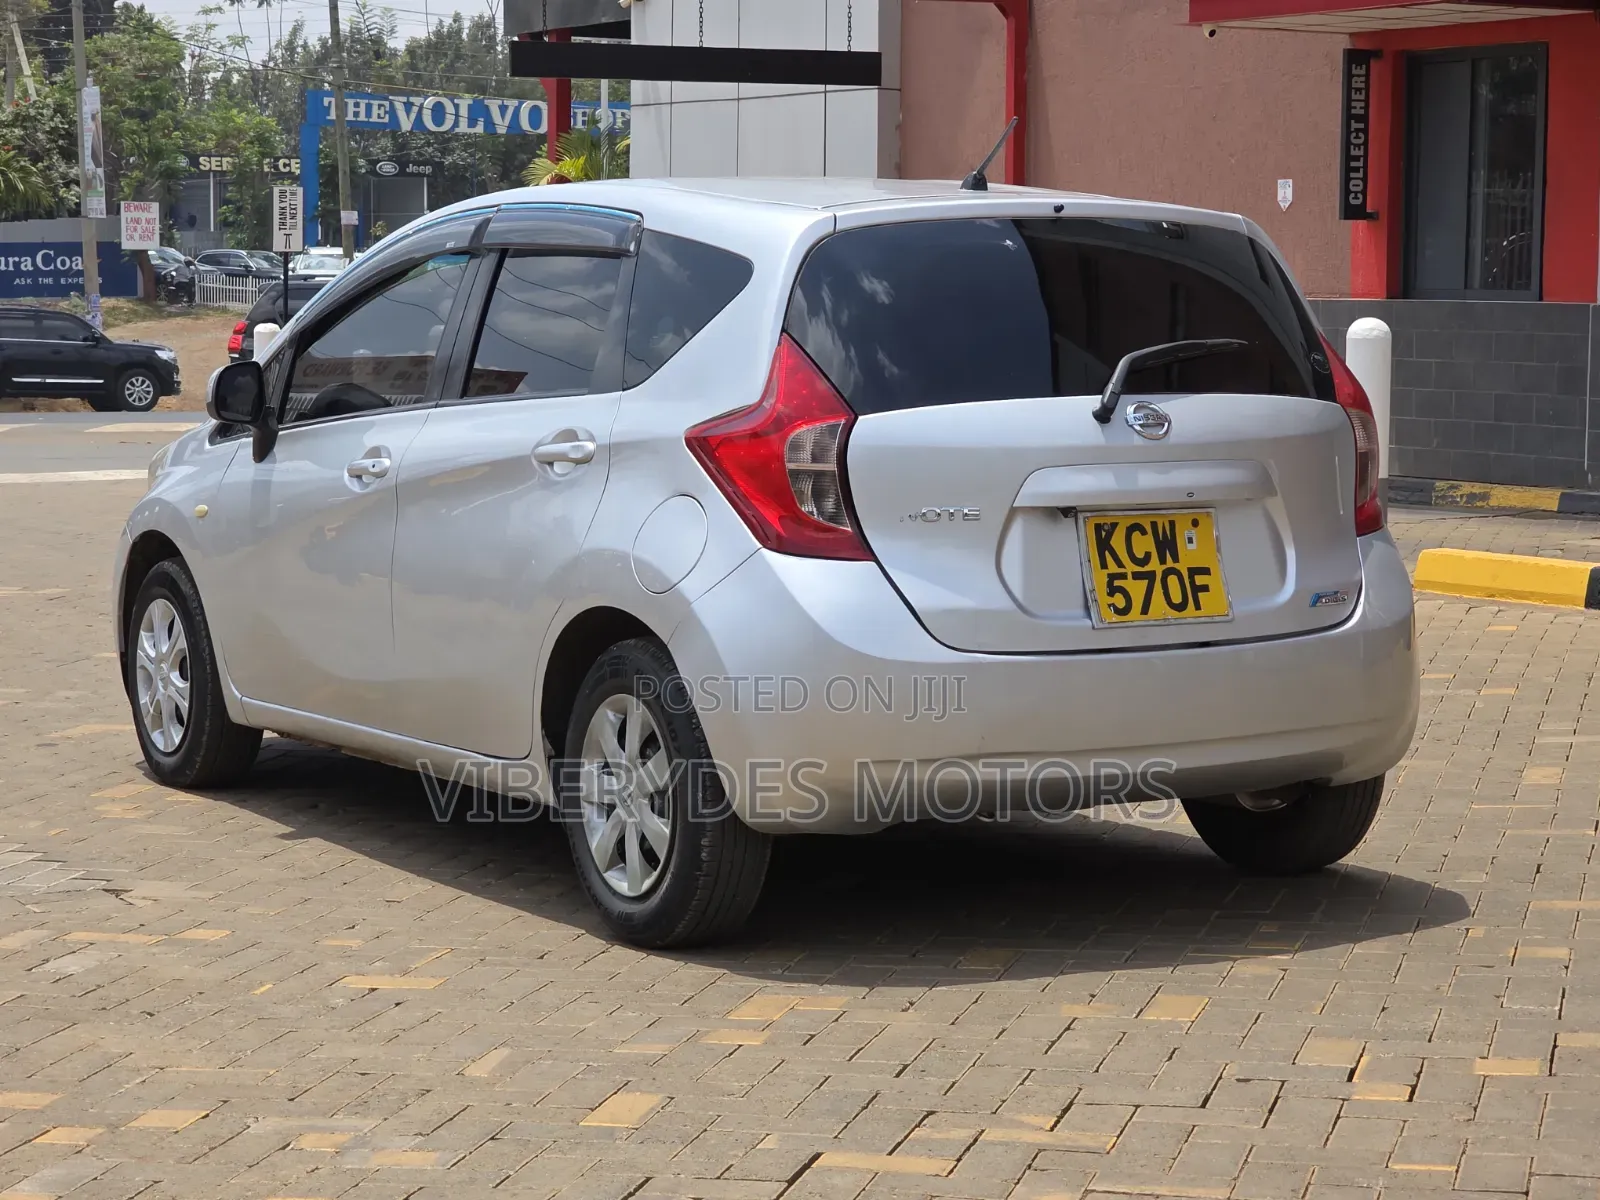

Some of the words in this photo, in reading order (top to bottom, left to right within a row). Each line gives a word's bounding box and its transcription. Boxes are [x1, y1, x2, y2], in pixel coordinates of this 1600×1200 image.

[1352, 63, 1367, 115] HERE
[323, 97, 390, 124] THE
[389, 95, 547, 135] VOLVO
[571, 107, 631, 130] HOP
[199, 156, 273, 173] SERE
[406, 163, 433, 175] Jeep
[1349, 120, 1365, 205] COLLECT
[278, 189, 288, 205] YOU
[288, 188, 298, 202] TIME
[123, 202, 154, 213] BEWARE
[288, 202, 298, 220] NEXT
[125, 216, 143, 226] LAND
[144, 217, 157, 226] NOT
[278, 206, 288, 231] THANK
[125, 225, 139, 234] FOR
[140, 226, 156, 235] SALE
[125, 233, 136, 242] OR
[138, 233, 155, 242] RENT
[0, 249, 84, 271] uraCoa
[13, 277, 33, 285] ASK
[38, 277, 54, 285] THE
[60, 276, 103, 285] EXPES
[1133, 413, 1167, 422] NISSAN
[1093, 519, 1181, 570] KCW
[1105, 566, 1212, 617] 570F
